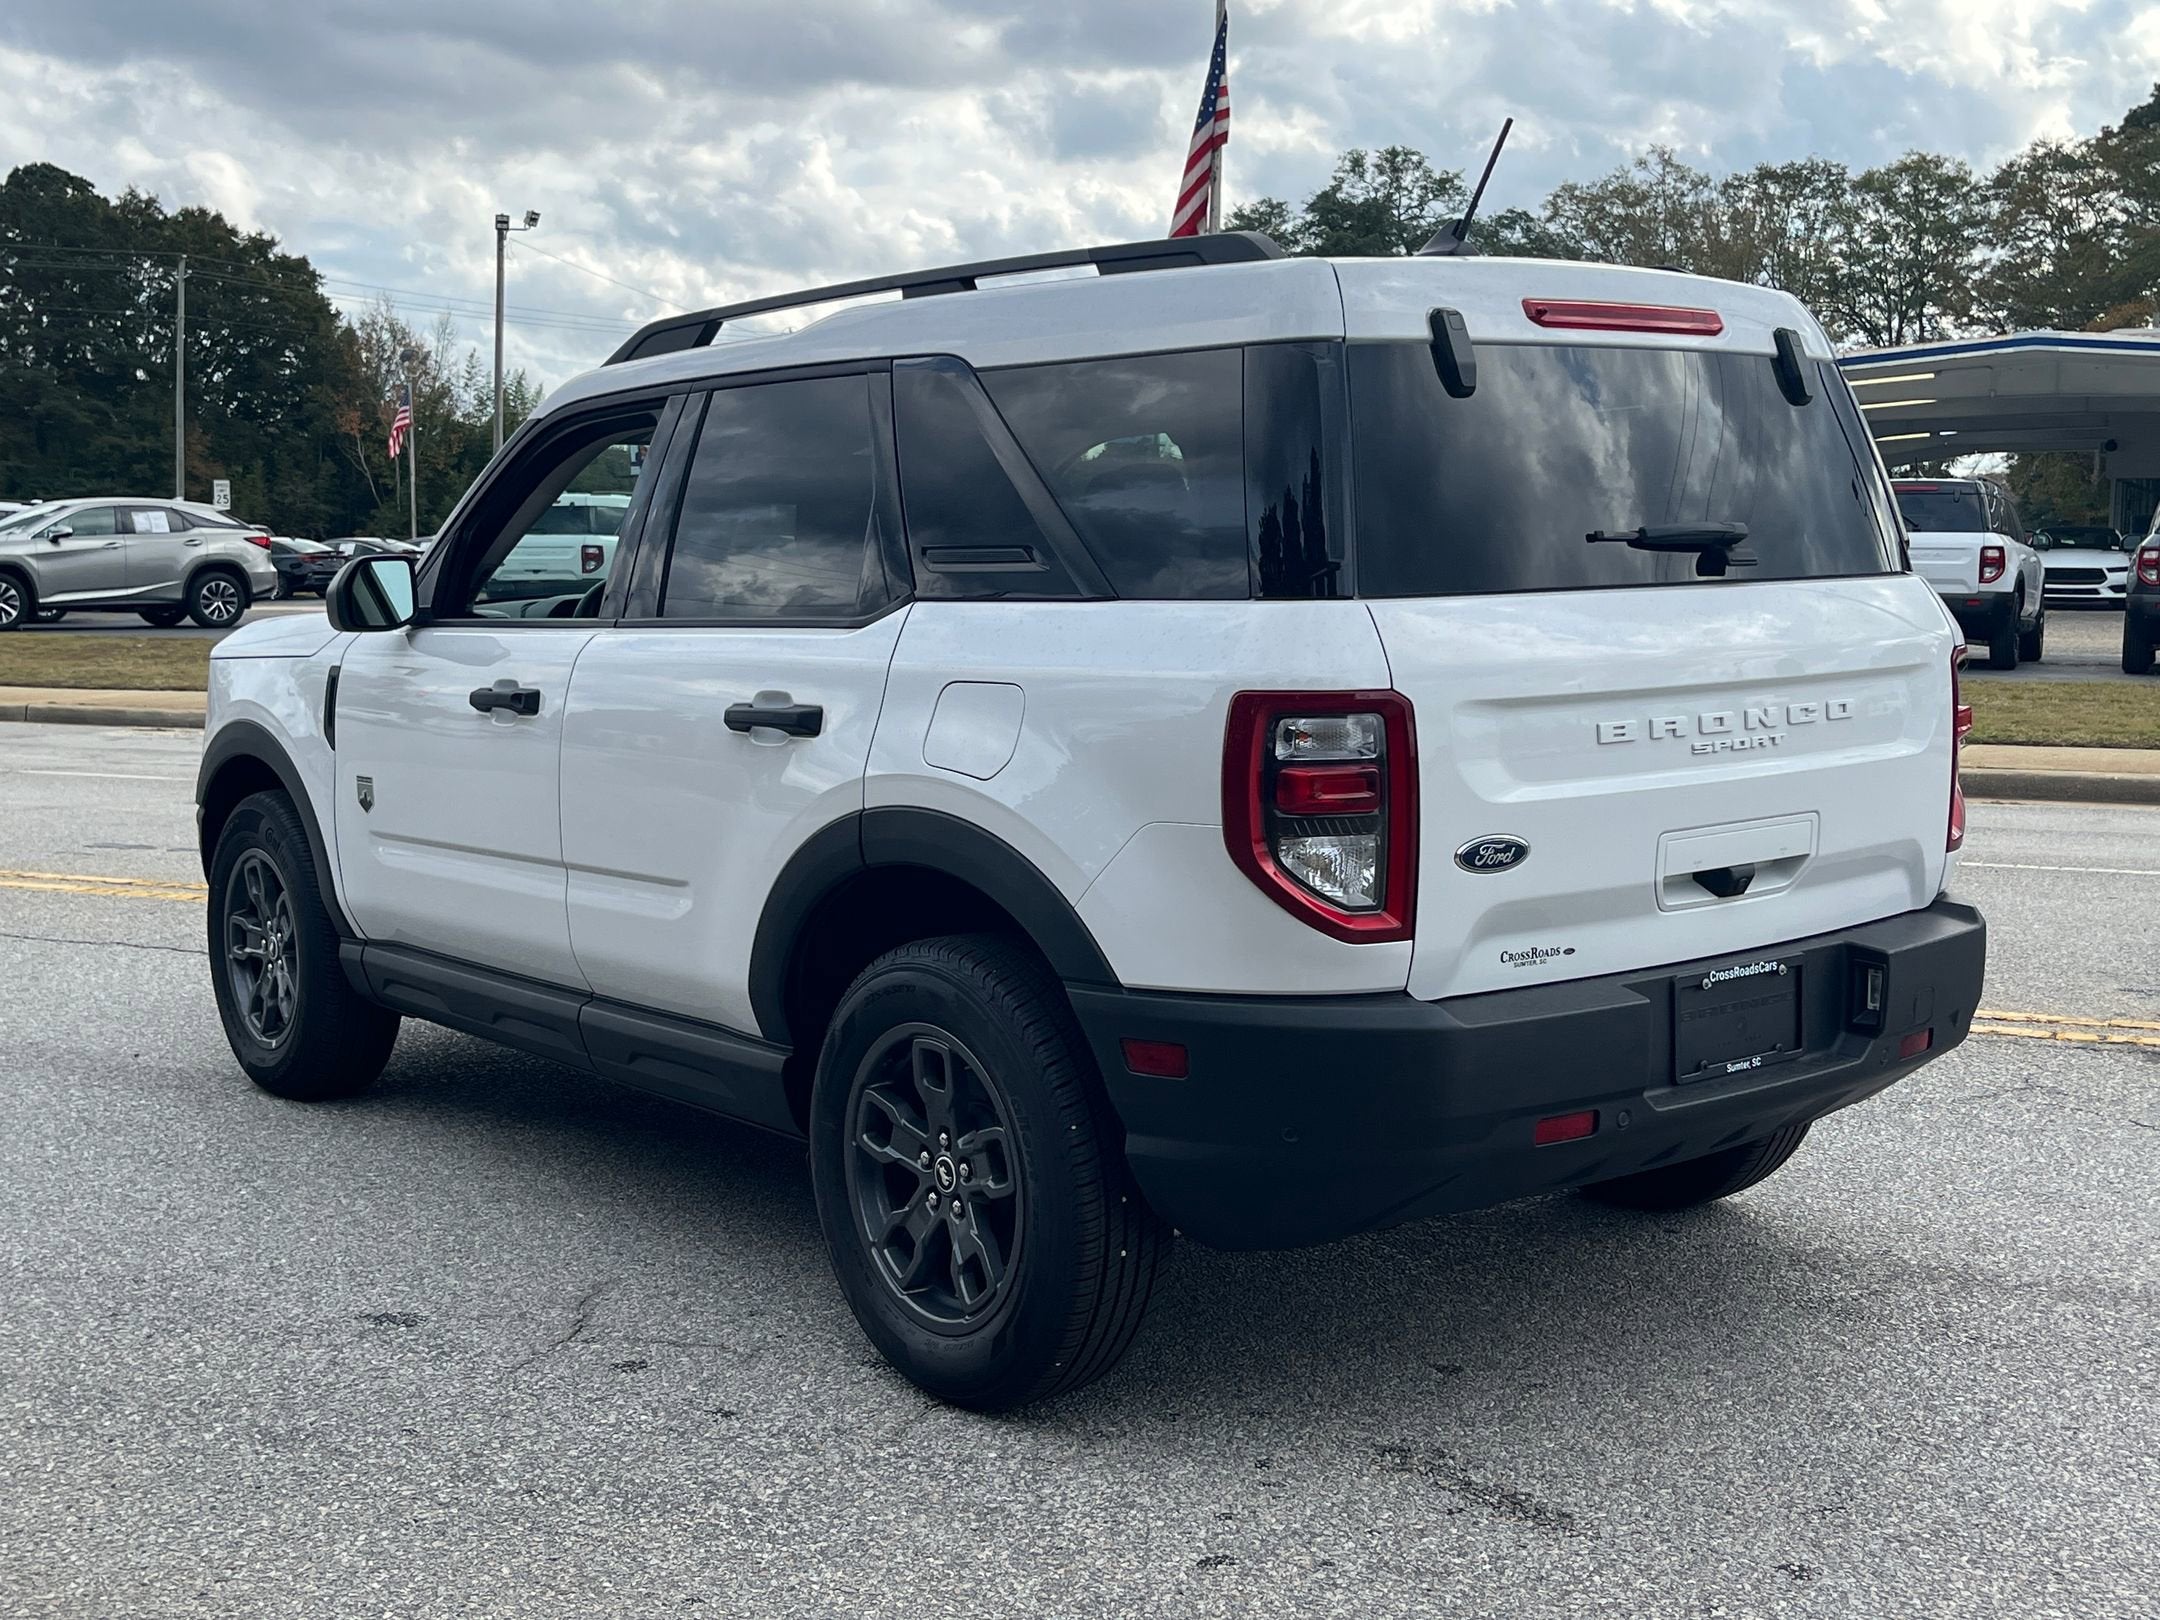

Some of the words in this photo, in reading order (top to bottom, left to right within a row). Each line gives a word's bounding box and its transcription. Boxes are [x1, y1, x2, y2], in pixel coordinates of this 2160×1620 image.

[217, 494, 229, 504] 25
[1596, 698, 1855, 744] BRONCO
[1691, 733, 1787, 755] SPORT
[1475, 843, 1516, 866] Ford
[1709, 961, 1778, 982] CrossRoadsCars
[1726, 1061, 1751, 1073] Sumter,
[1751, 1057, 1762, 1067] SC
